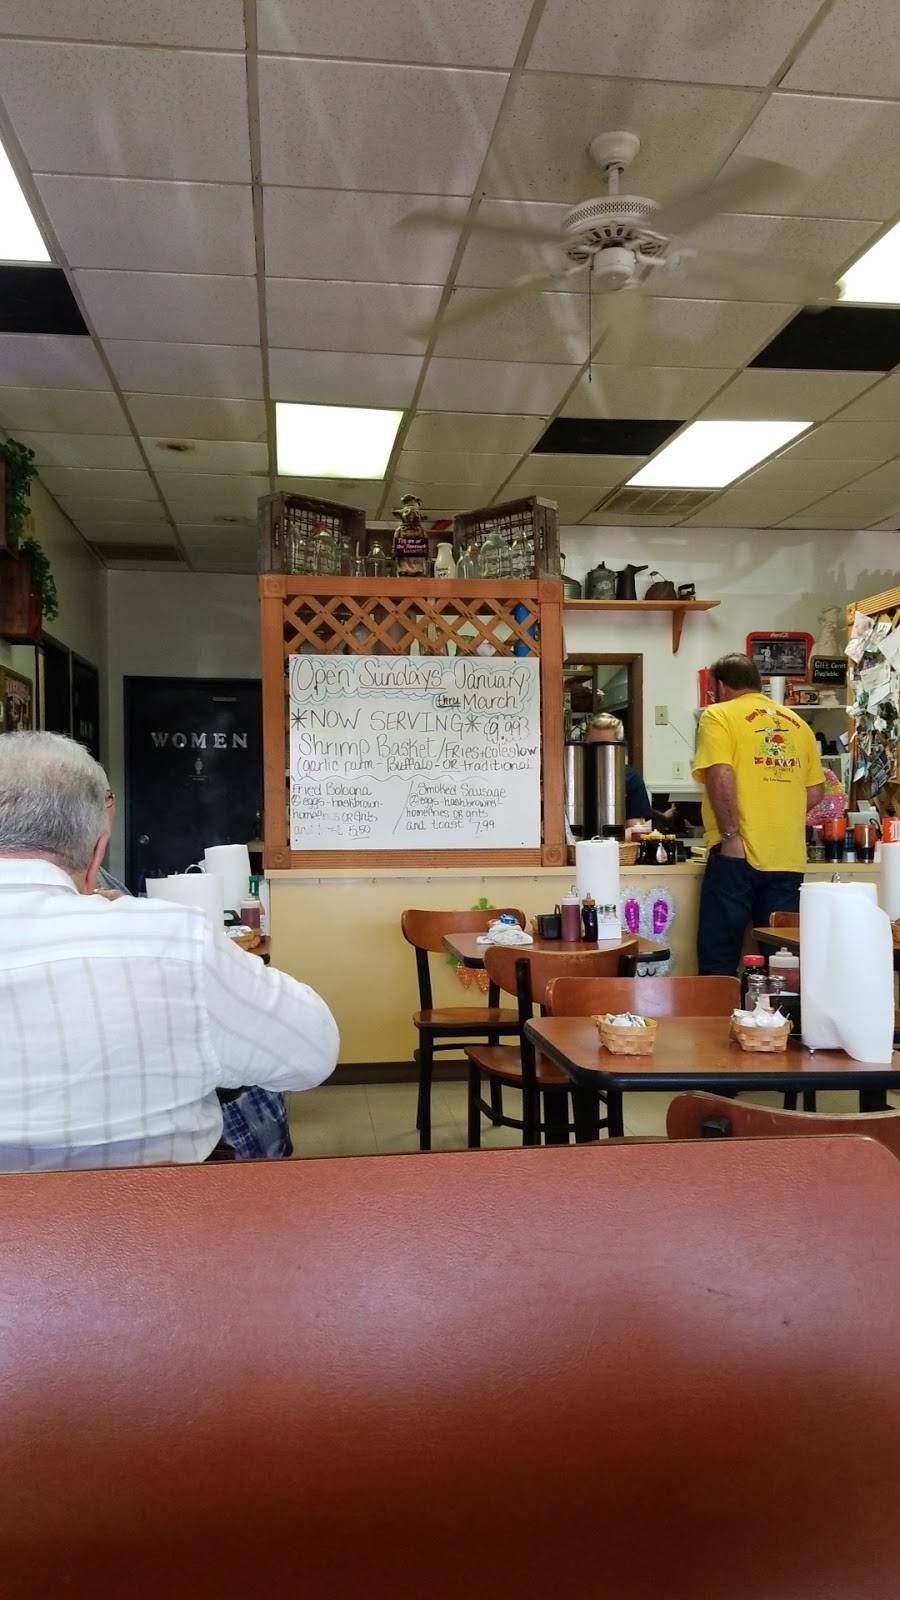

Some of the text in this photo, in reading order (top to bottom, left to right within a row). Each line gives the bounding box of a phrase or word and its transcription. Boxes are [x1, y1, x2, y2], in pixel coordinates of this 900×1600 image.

[297, 658, 525, 696] Open Sundays January
[437, 690, 516, 709] thru March
[150, 732, 249, 748] WOMEN
[299, 733, 370, 761] Shrimp
[376, 733, 437, 758] Basket
[461, 758, 530, 771] traditional
[293, 783, 322, 796] Fried
[418, 783, 507, 801] Smoked Sausage
[406, 819, 496, 835] and toast 7.99
